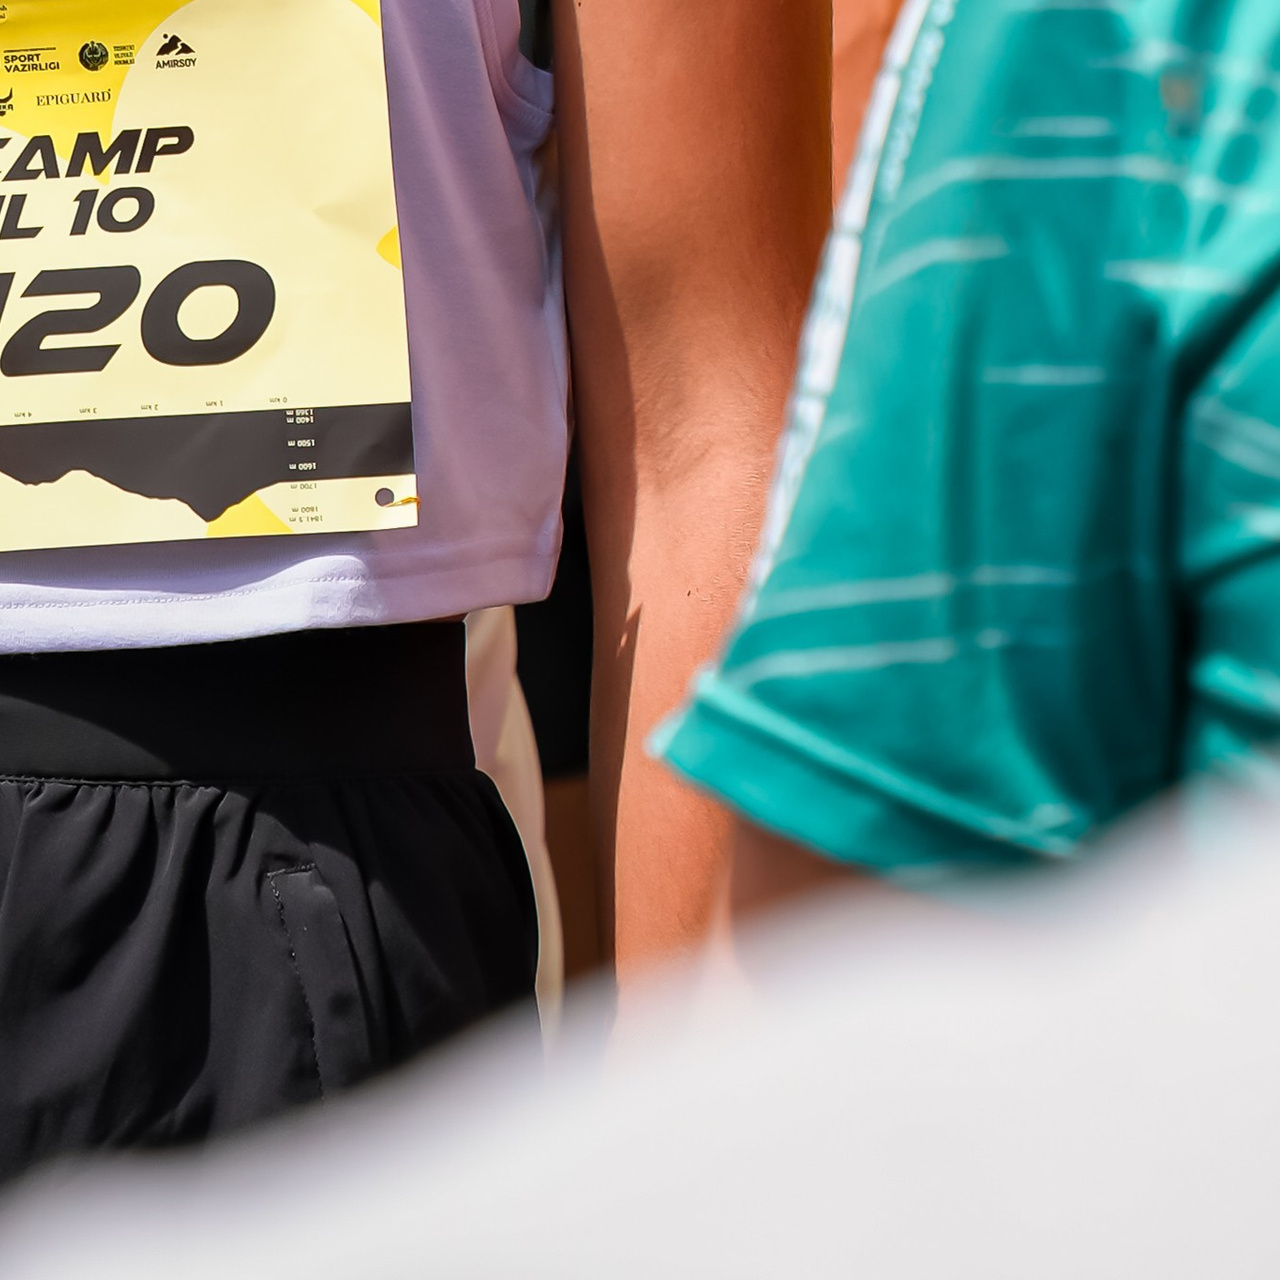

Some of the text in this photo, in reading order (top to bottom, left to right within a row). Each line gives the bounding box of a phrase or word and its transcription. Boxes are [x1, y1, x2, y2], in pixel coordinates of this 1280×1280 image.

[4, 53, 41, 64] SPORT
[155, 57, 197, 69] AMIRSOY
[4, 61, 60, 72] VAZIRLIGI
[36, 90, 111, 107] EPIGUARD
[69, 186, 155, 236] 10
[295, 416, 314, 424] 1400
[297, 439, 315, 447] 1500
[298, 462, 317, 471] 1600
